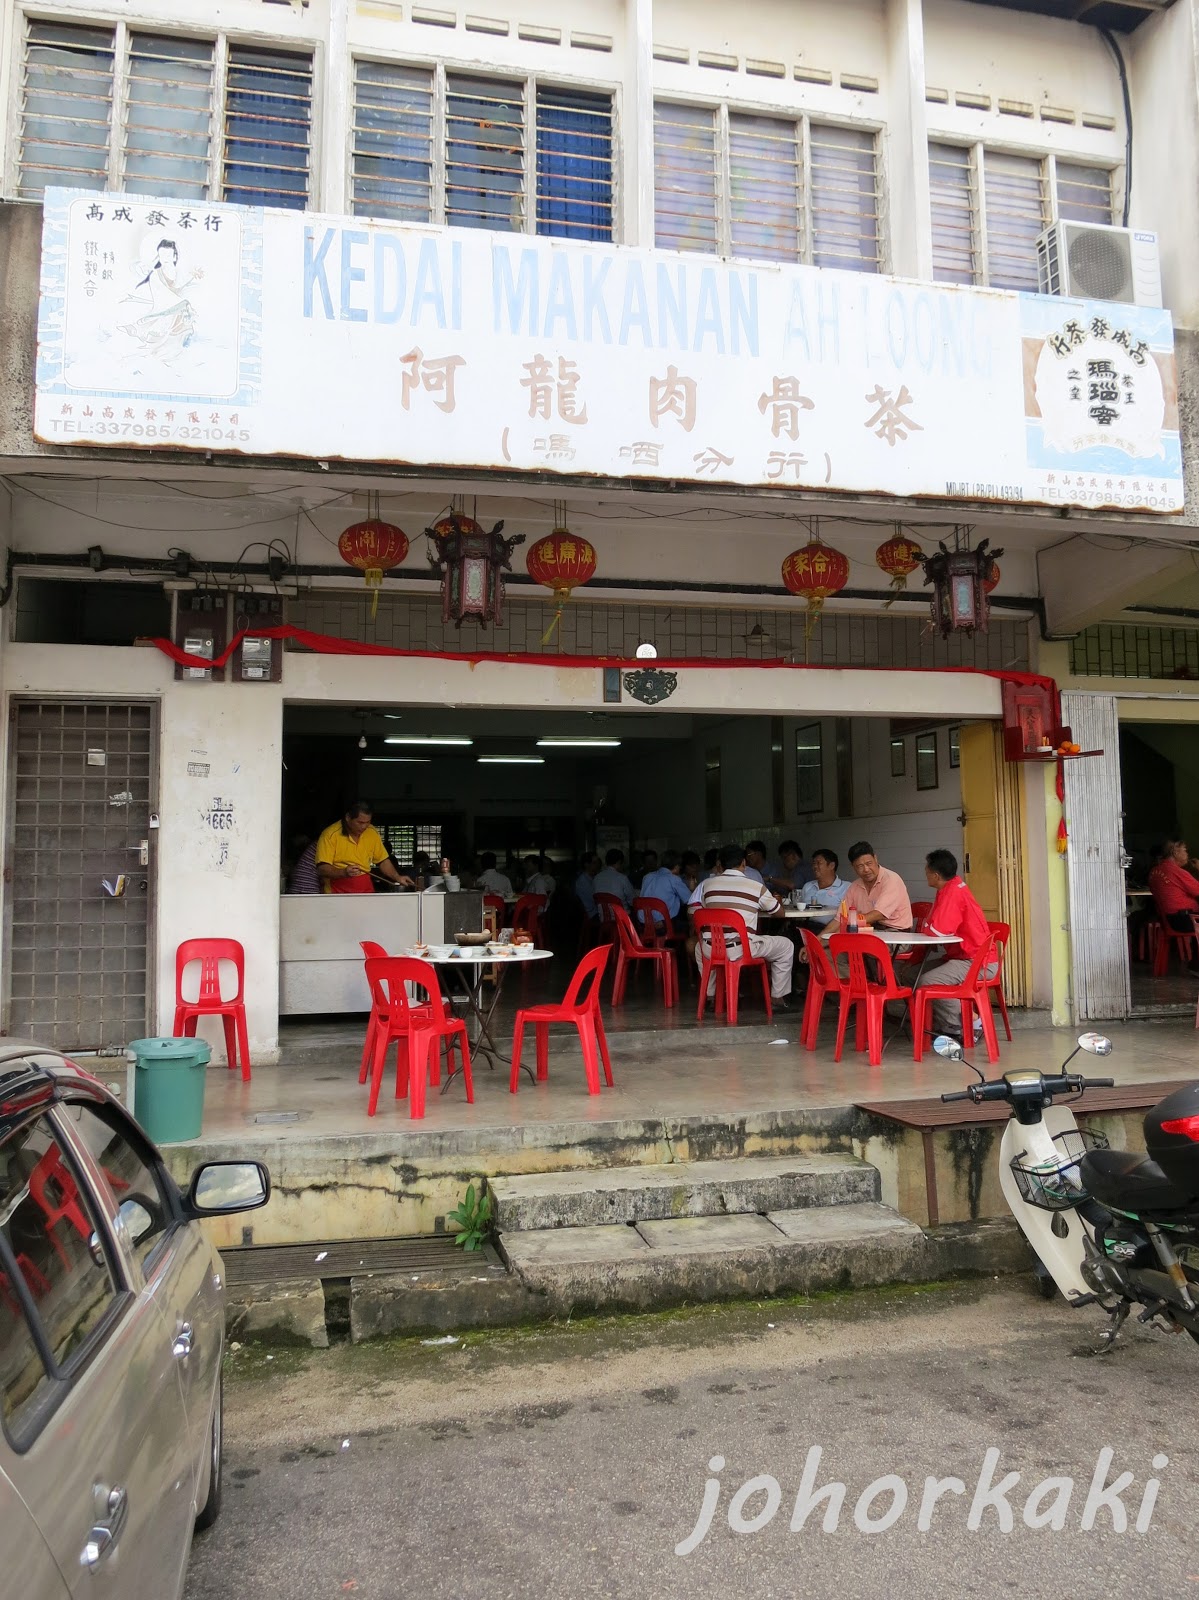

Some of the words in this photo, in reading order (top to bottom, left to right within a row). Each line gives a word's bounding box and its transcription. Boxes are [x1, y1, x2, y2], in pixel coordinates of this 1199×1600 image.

[303, 226, 462, 330] KEDAI
[491, 246, 760, 357] MAKANAN
[783, 277, 840, 364] AH
[50, 419, 250, 442] TEL:337985/321045
[399, 346, 924, 447] 阿龍肉骨茶
